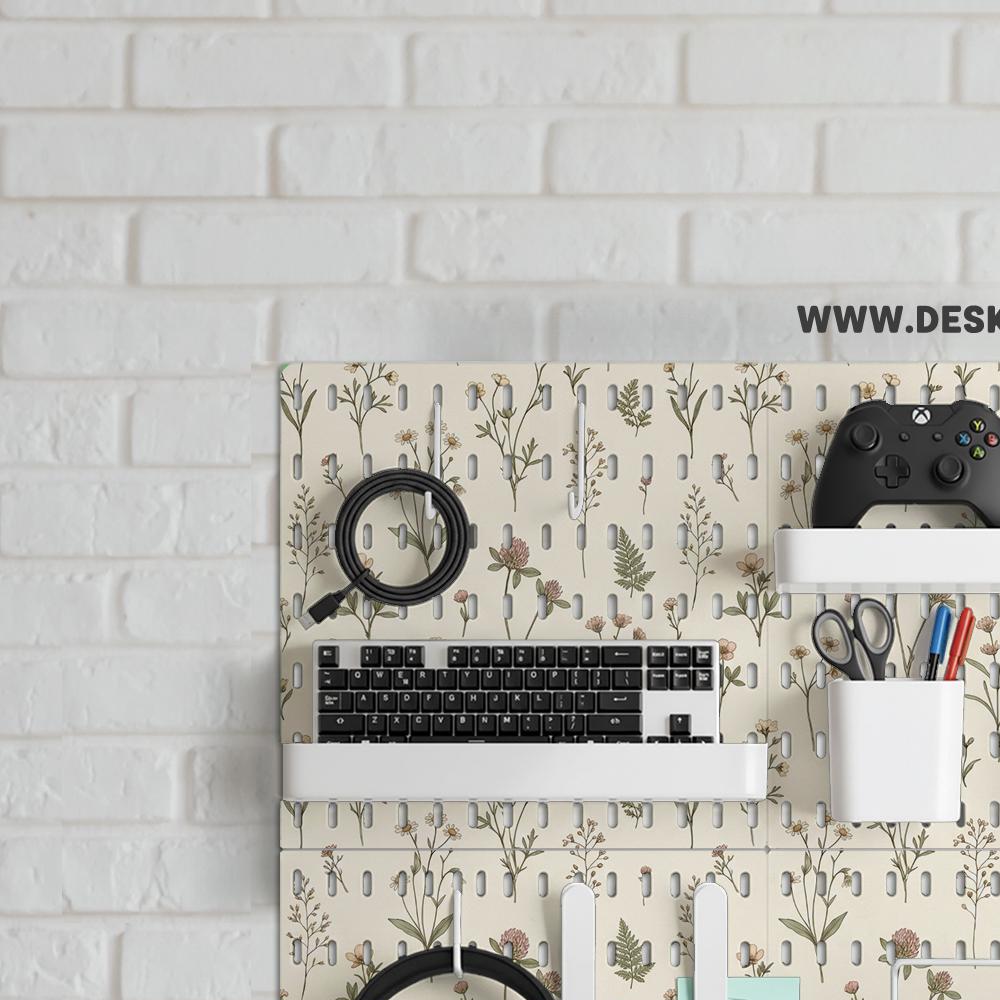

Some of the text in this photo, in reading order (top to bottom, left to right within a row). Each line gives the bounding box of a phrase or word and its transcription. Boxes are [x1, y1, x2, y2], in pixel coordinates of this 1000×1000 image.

[972, 420, 982, 431] Y
[959, 433, 968, 444] X
[972, 446, 982, 457] A
